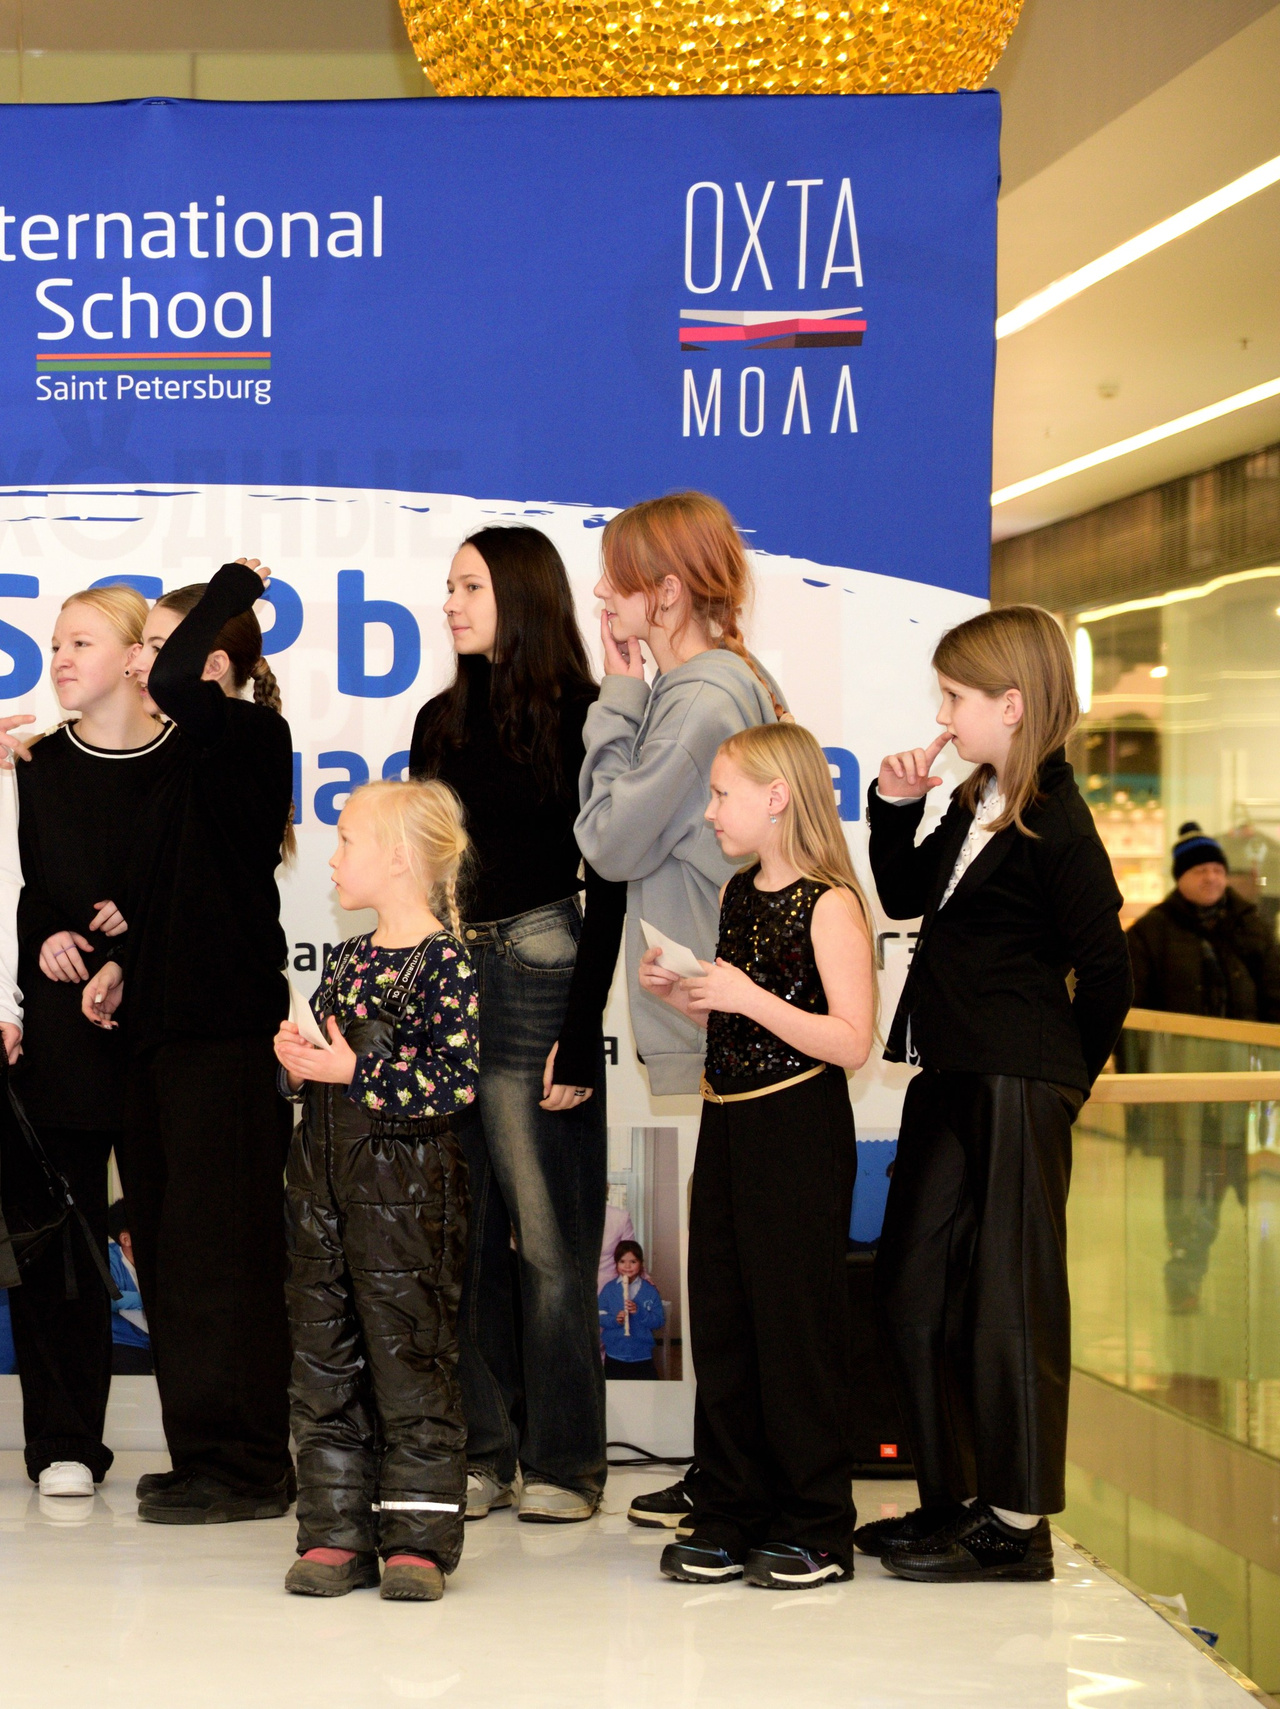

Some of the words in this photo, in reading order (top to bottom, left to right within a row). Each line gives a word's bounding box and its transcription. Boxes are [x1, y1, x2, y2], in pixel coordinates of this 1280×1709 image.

[683, 177, 864, 294] ОХТА
[35, 275, 272, 341] School
[35, 374, 108, 402] Saint
[115, 373, 272, 405] Petersburg
[682, 364, 859, 437] МОЛЛ
[401, 951, 422, 983] FUTURINO
